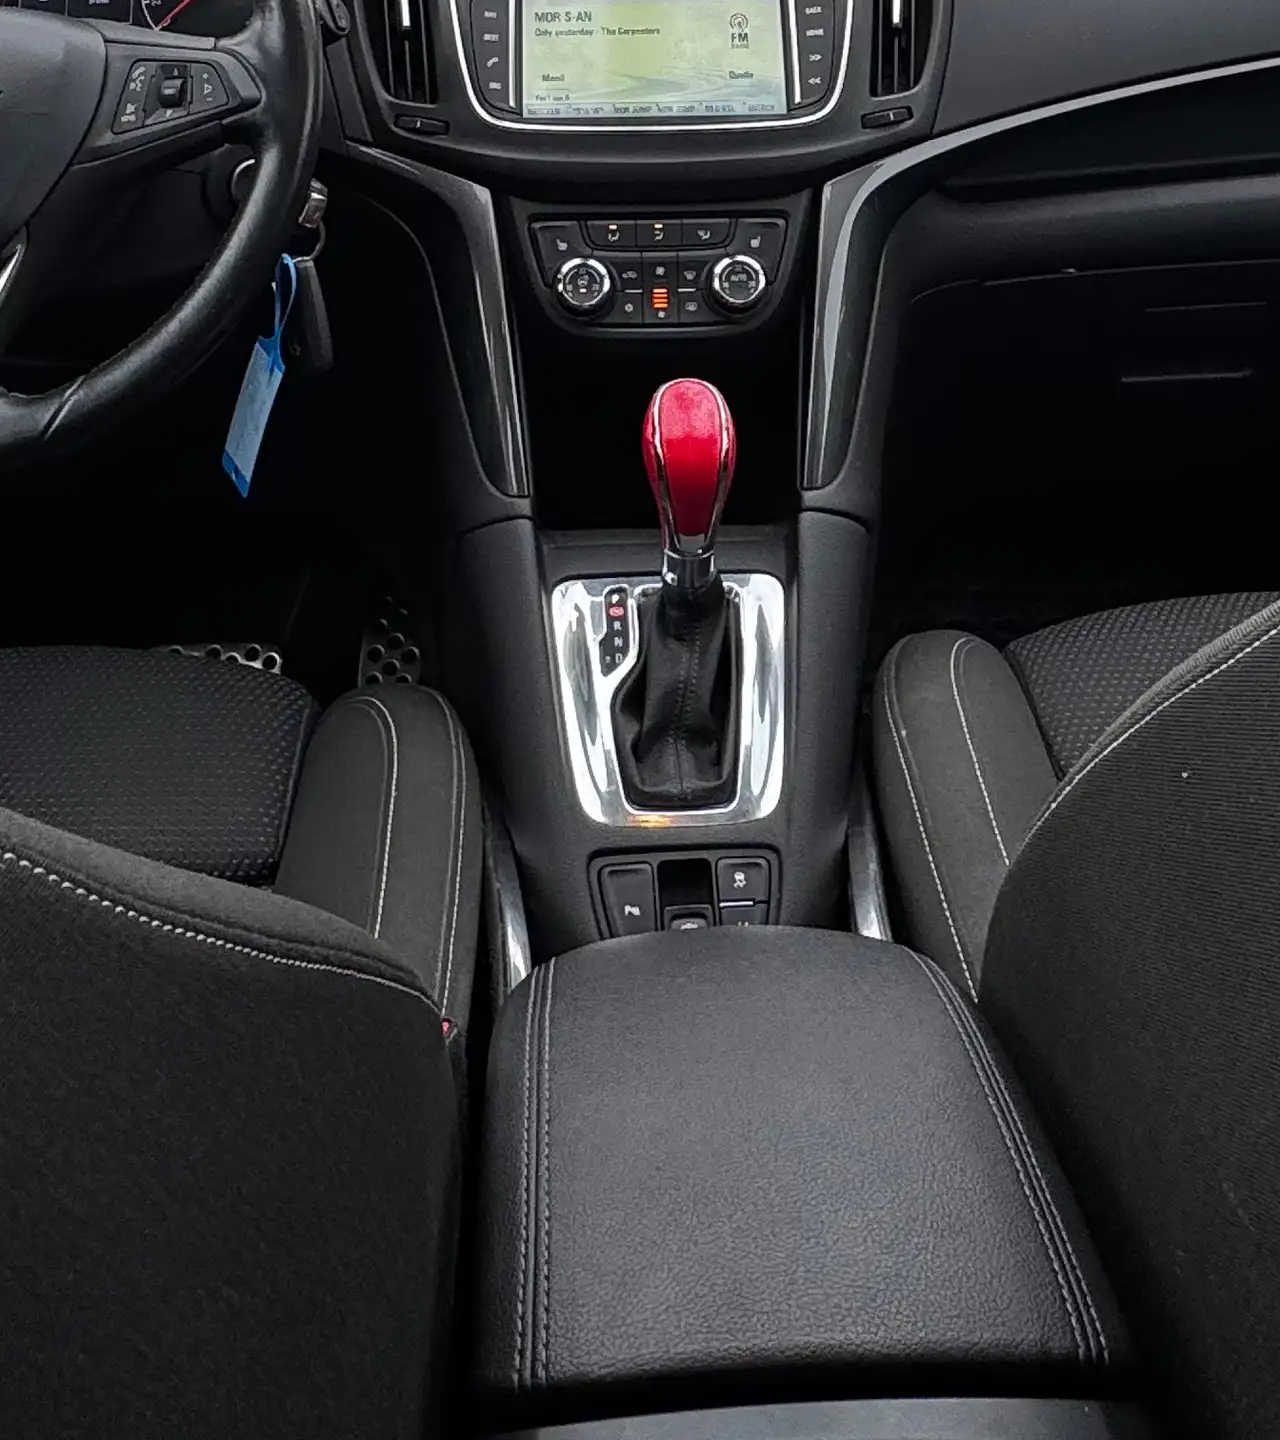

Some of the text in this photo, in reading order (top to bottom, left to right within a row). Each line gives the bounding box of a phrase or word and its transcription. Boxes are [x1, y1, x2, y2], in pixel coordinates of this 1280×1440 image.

[534, 10, 592, 23] MDR S-AN
[731, 32, 749, 43] FM
[613, 620, 622, 631] R
[614, 636, 623, 648] N
